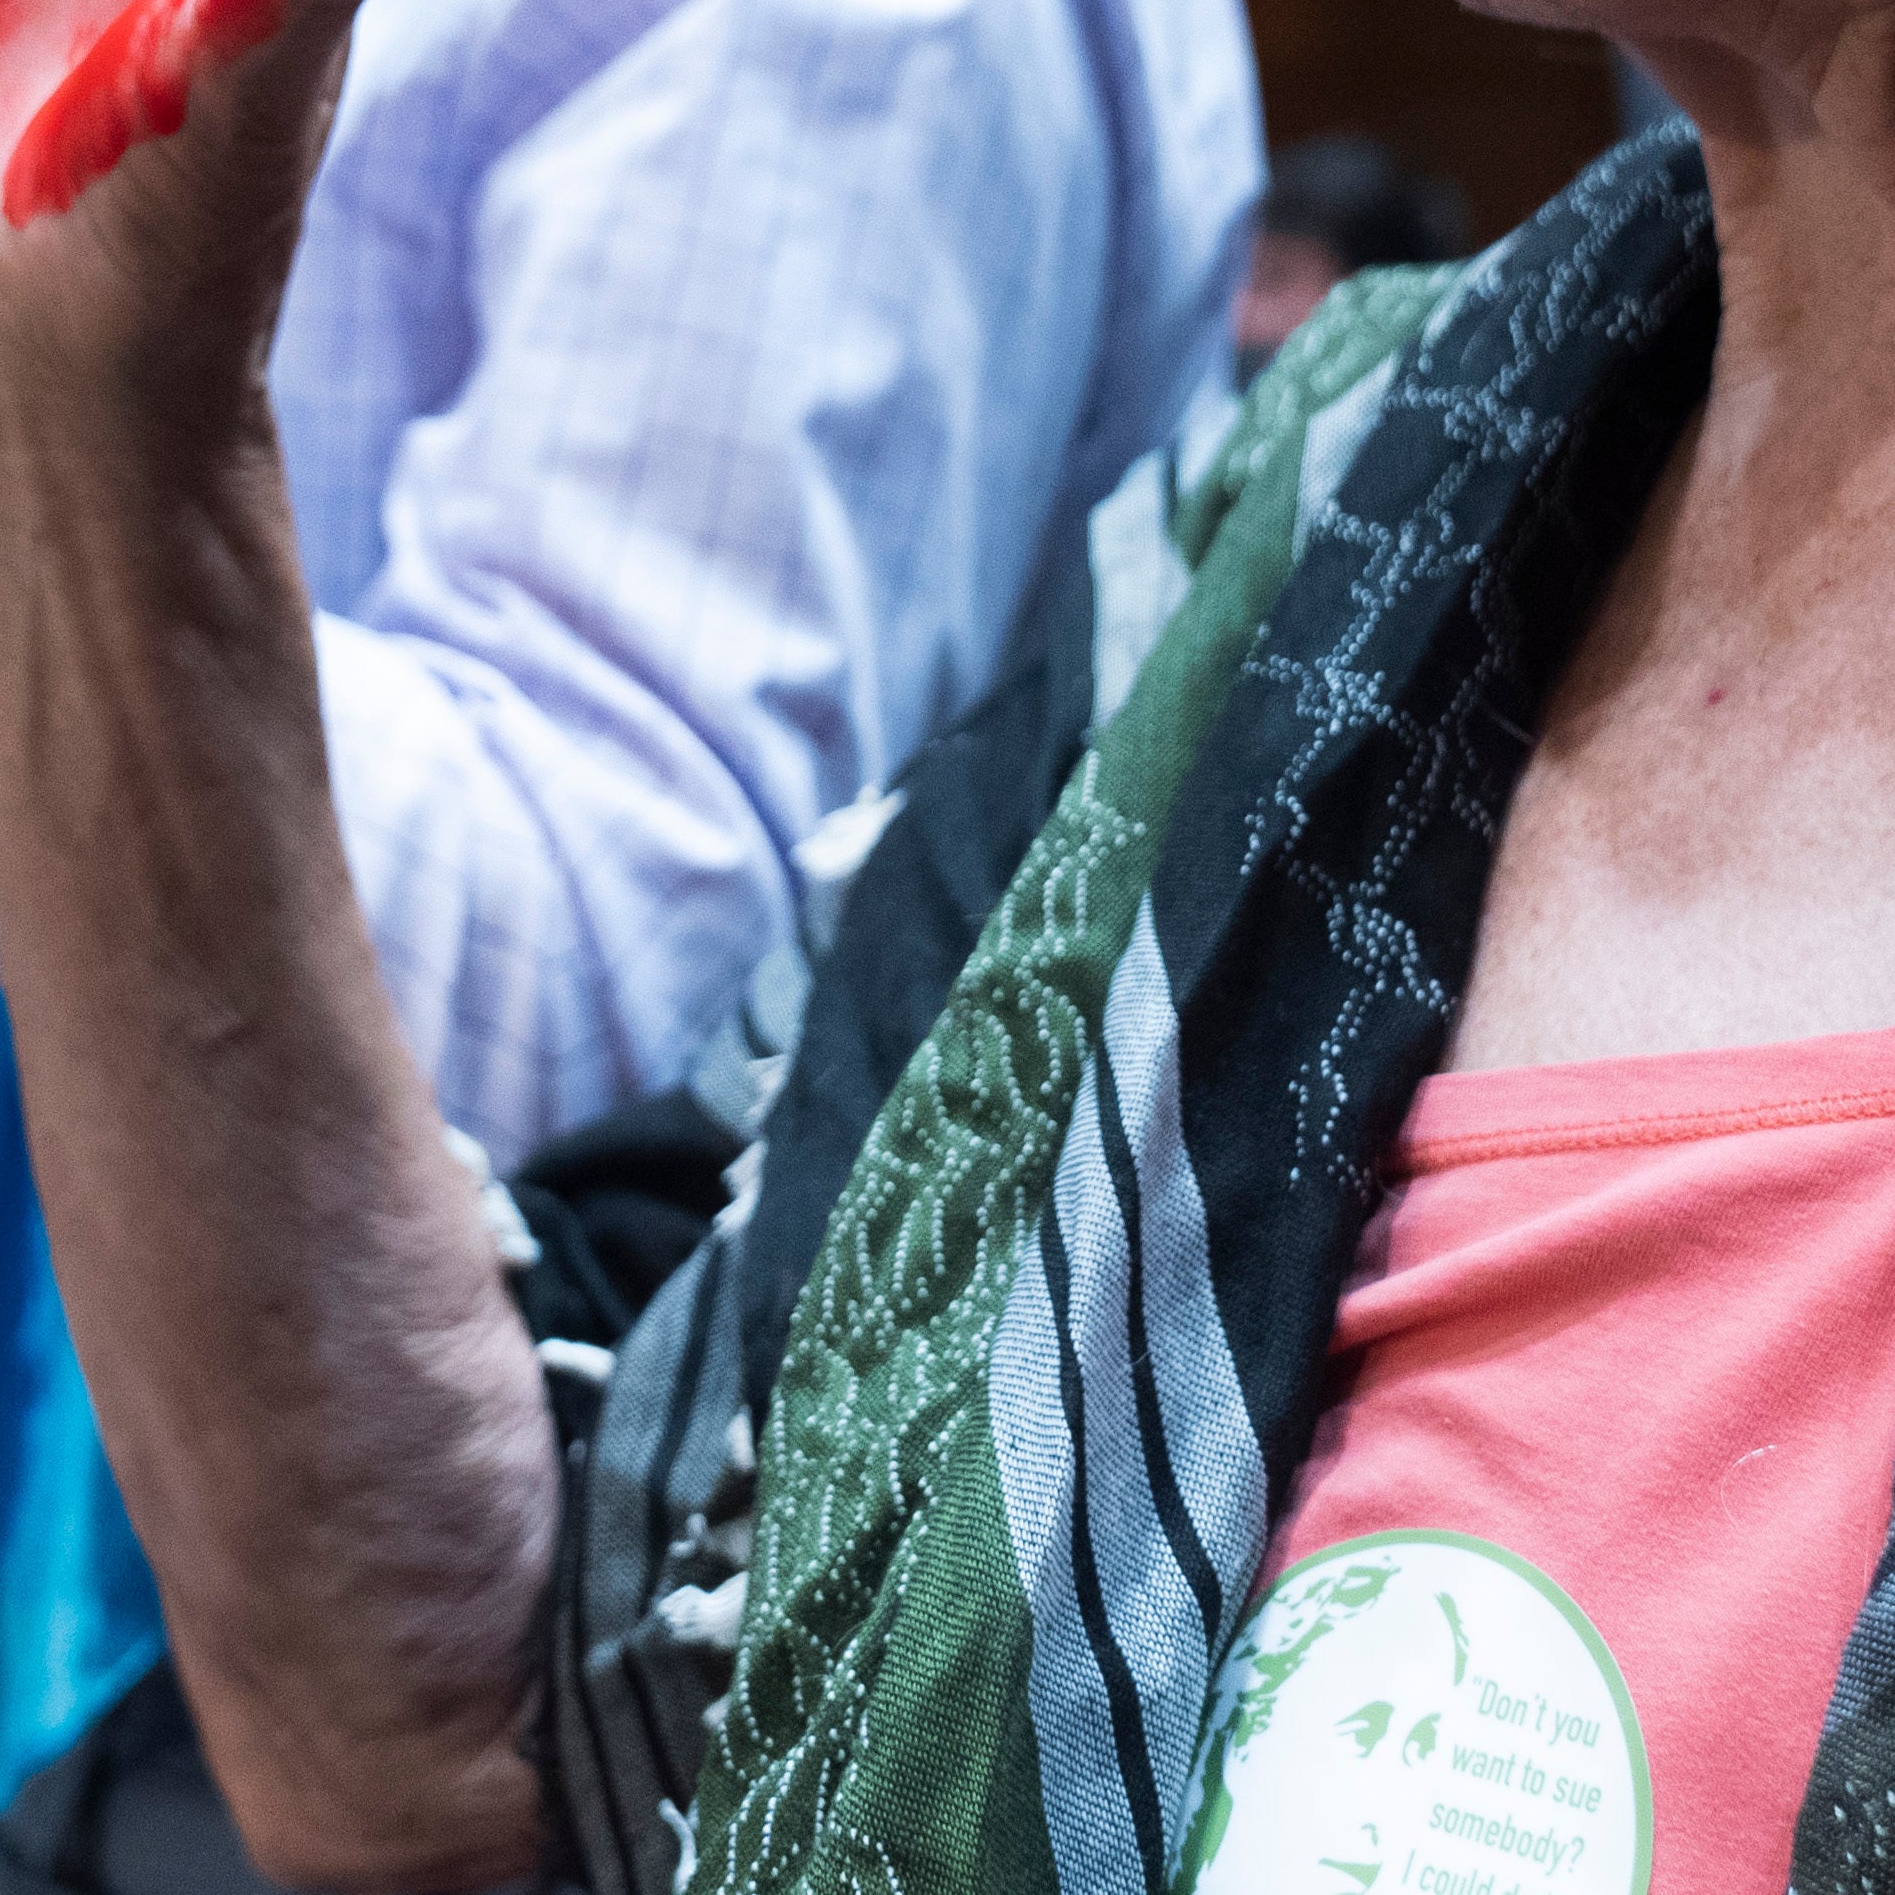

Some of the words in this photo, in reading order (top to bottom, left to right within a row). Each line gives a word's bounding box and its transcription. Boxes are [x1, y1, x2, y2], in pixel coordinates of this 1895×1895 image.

[1548, 1709, 1601, 1747] you
[1451, 1743, 1517, 1787] want
[1520, 1756, 1546, 1796] to
[1553, 1775, 1602, 1813] sue
[1402, 1848, 1416, 1885] I
[1429, 1802, 1585, 1877] somebody?
